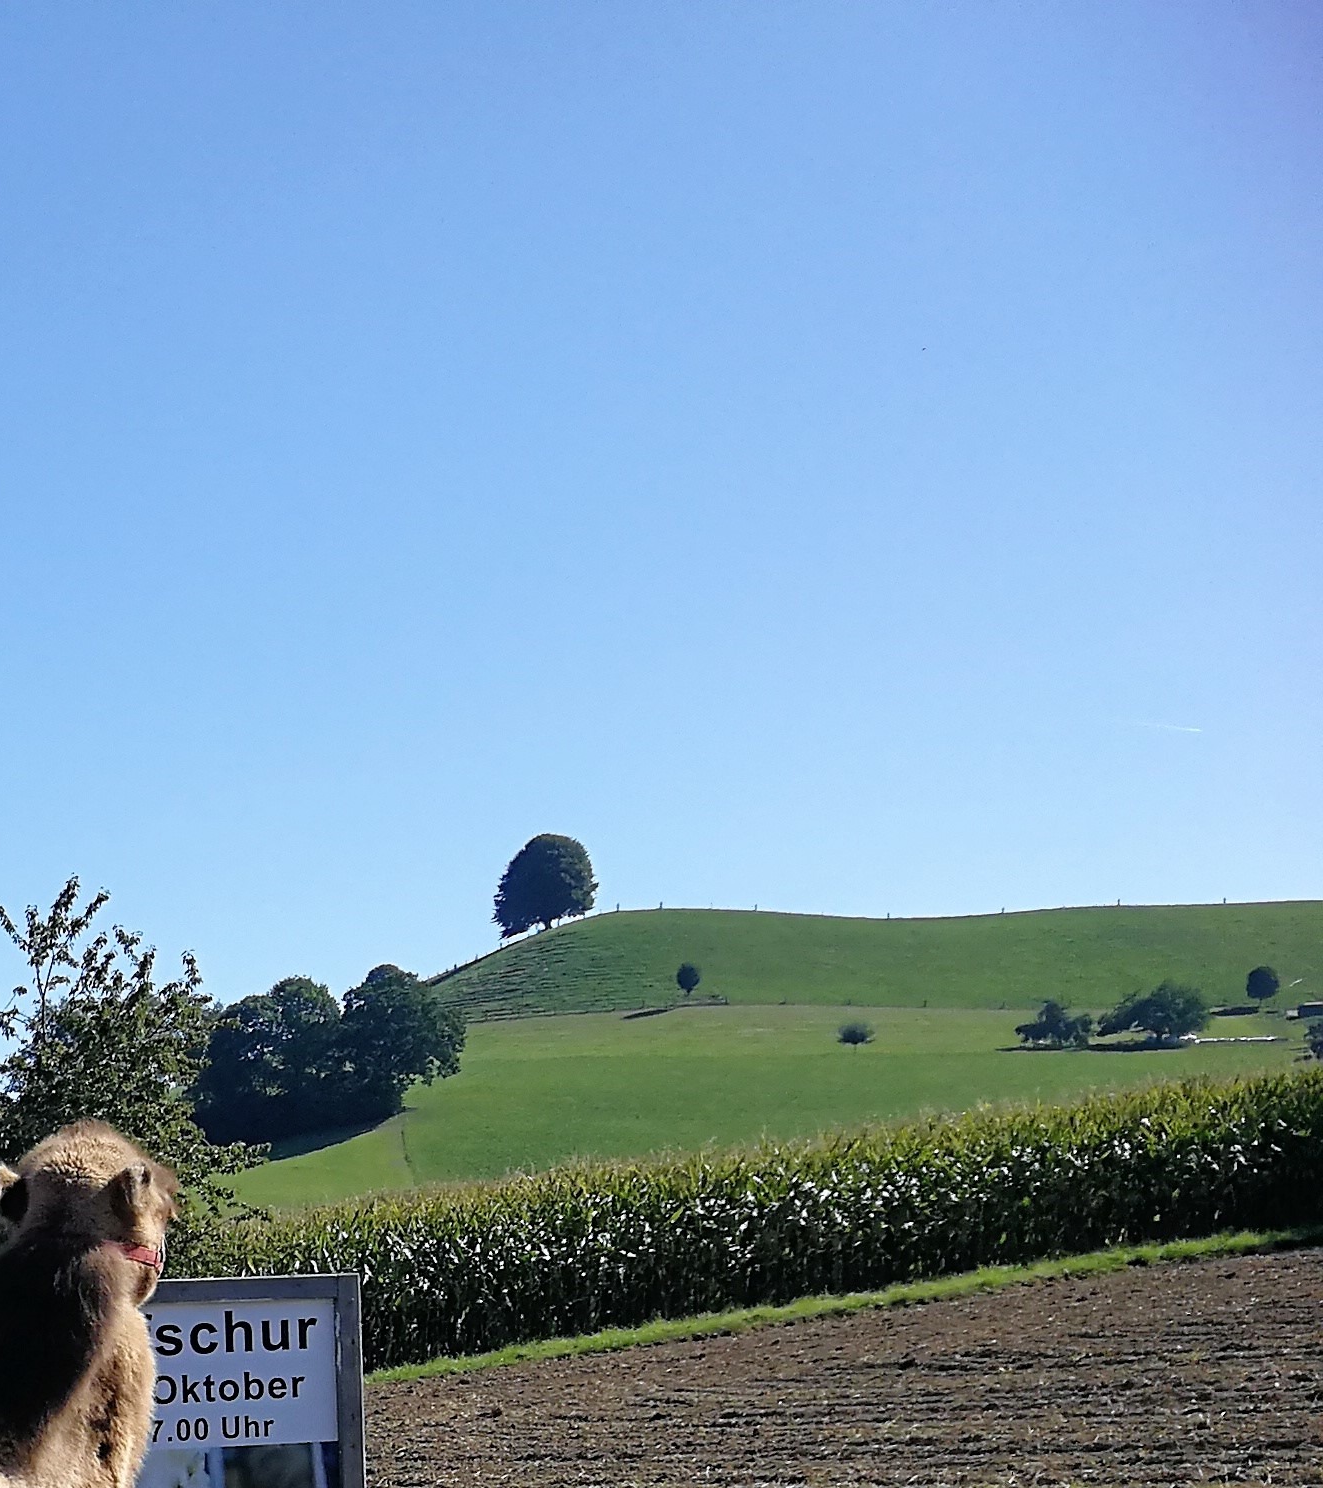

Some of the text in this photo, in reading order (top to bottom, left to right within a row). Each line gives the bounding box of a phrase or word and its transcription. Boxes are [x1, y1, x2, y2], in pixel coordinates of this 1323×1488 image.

[146, 1310, 318, 1356] schur
[154, 1371, 305, 1405] Oktober
[221, 1414, 275, 1440] Uhr
